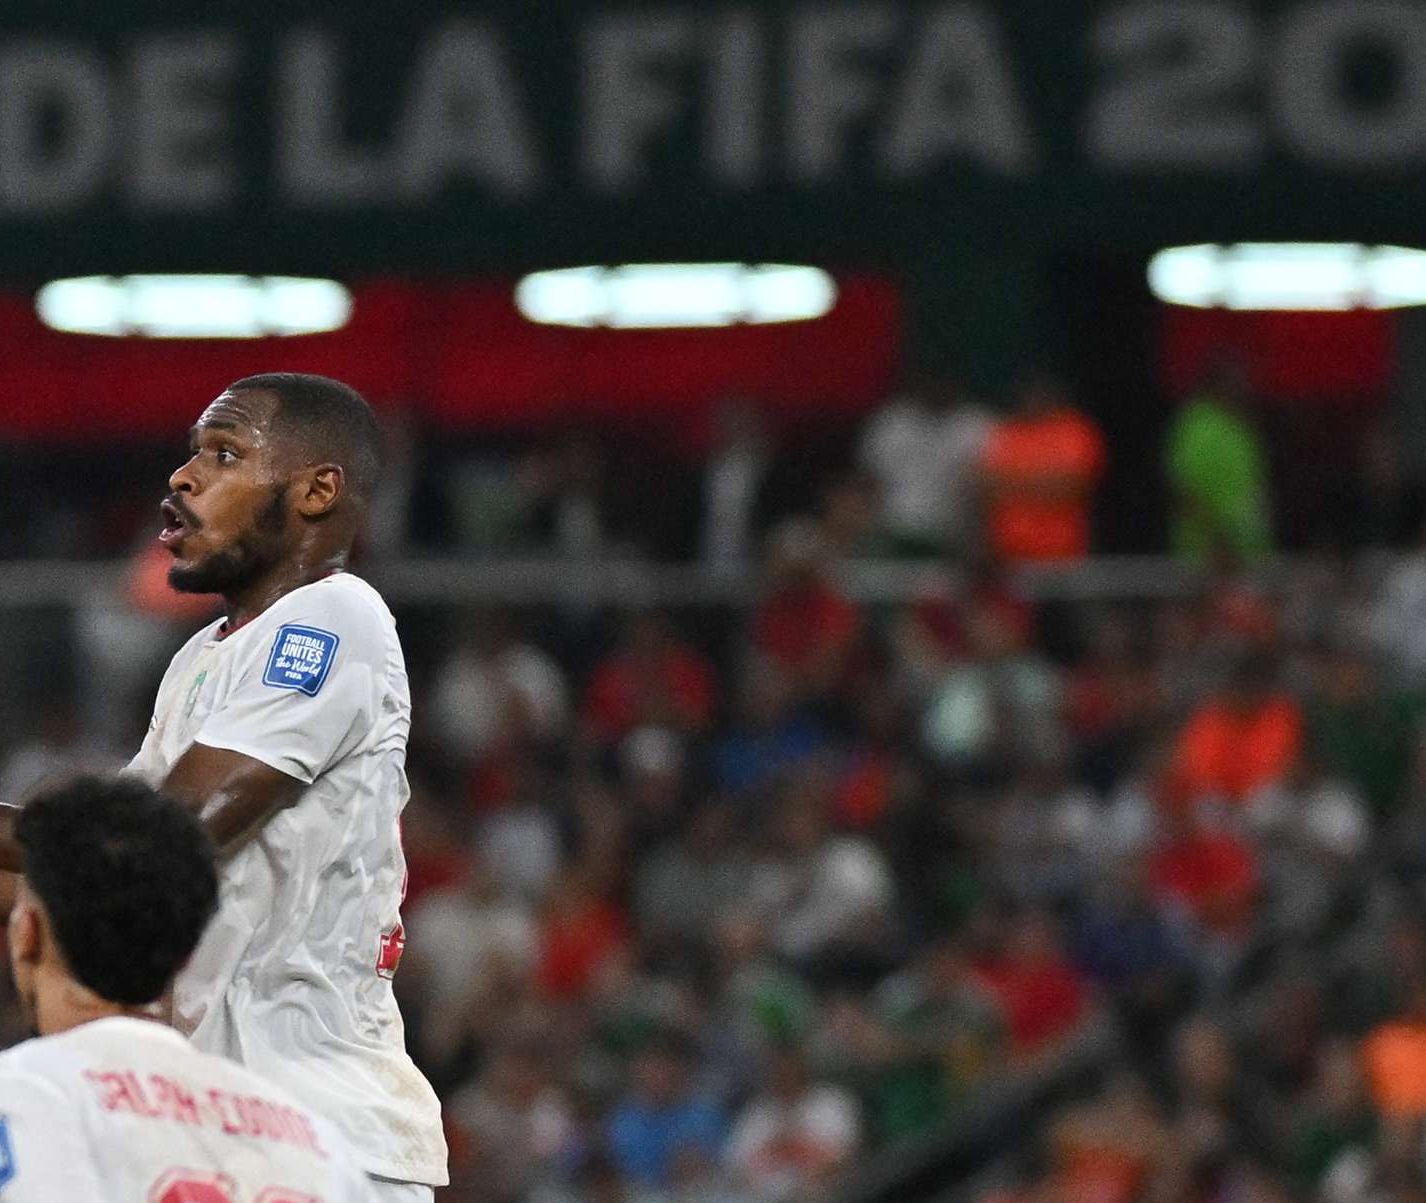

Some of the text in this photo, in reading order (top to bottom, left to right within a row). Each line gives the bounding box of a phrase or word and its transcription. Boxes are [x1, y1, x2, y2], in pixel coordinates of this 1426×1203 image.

[268, 16, 546, 206] LA
[573, 8, 1040, 188] FIFA
[286, 634, 325, 651] FOOTBALL
[282, 643, 323, 664] UNITES
